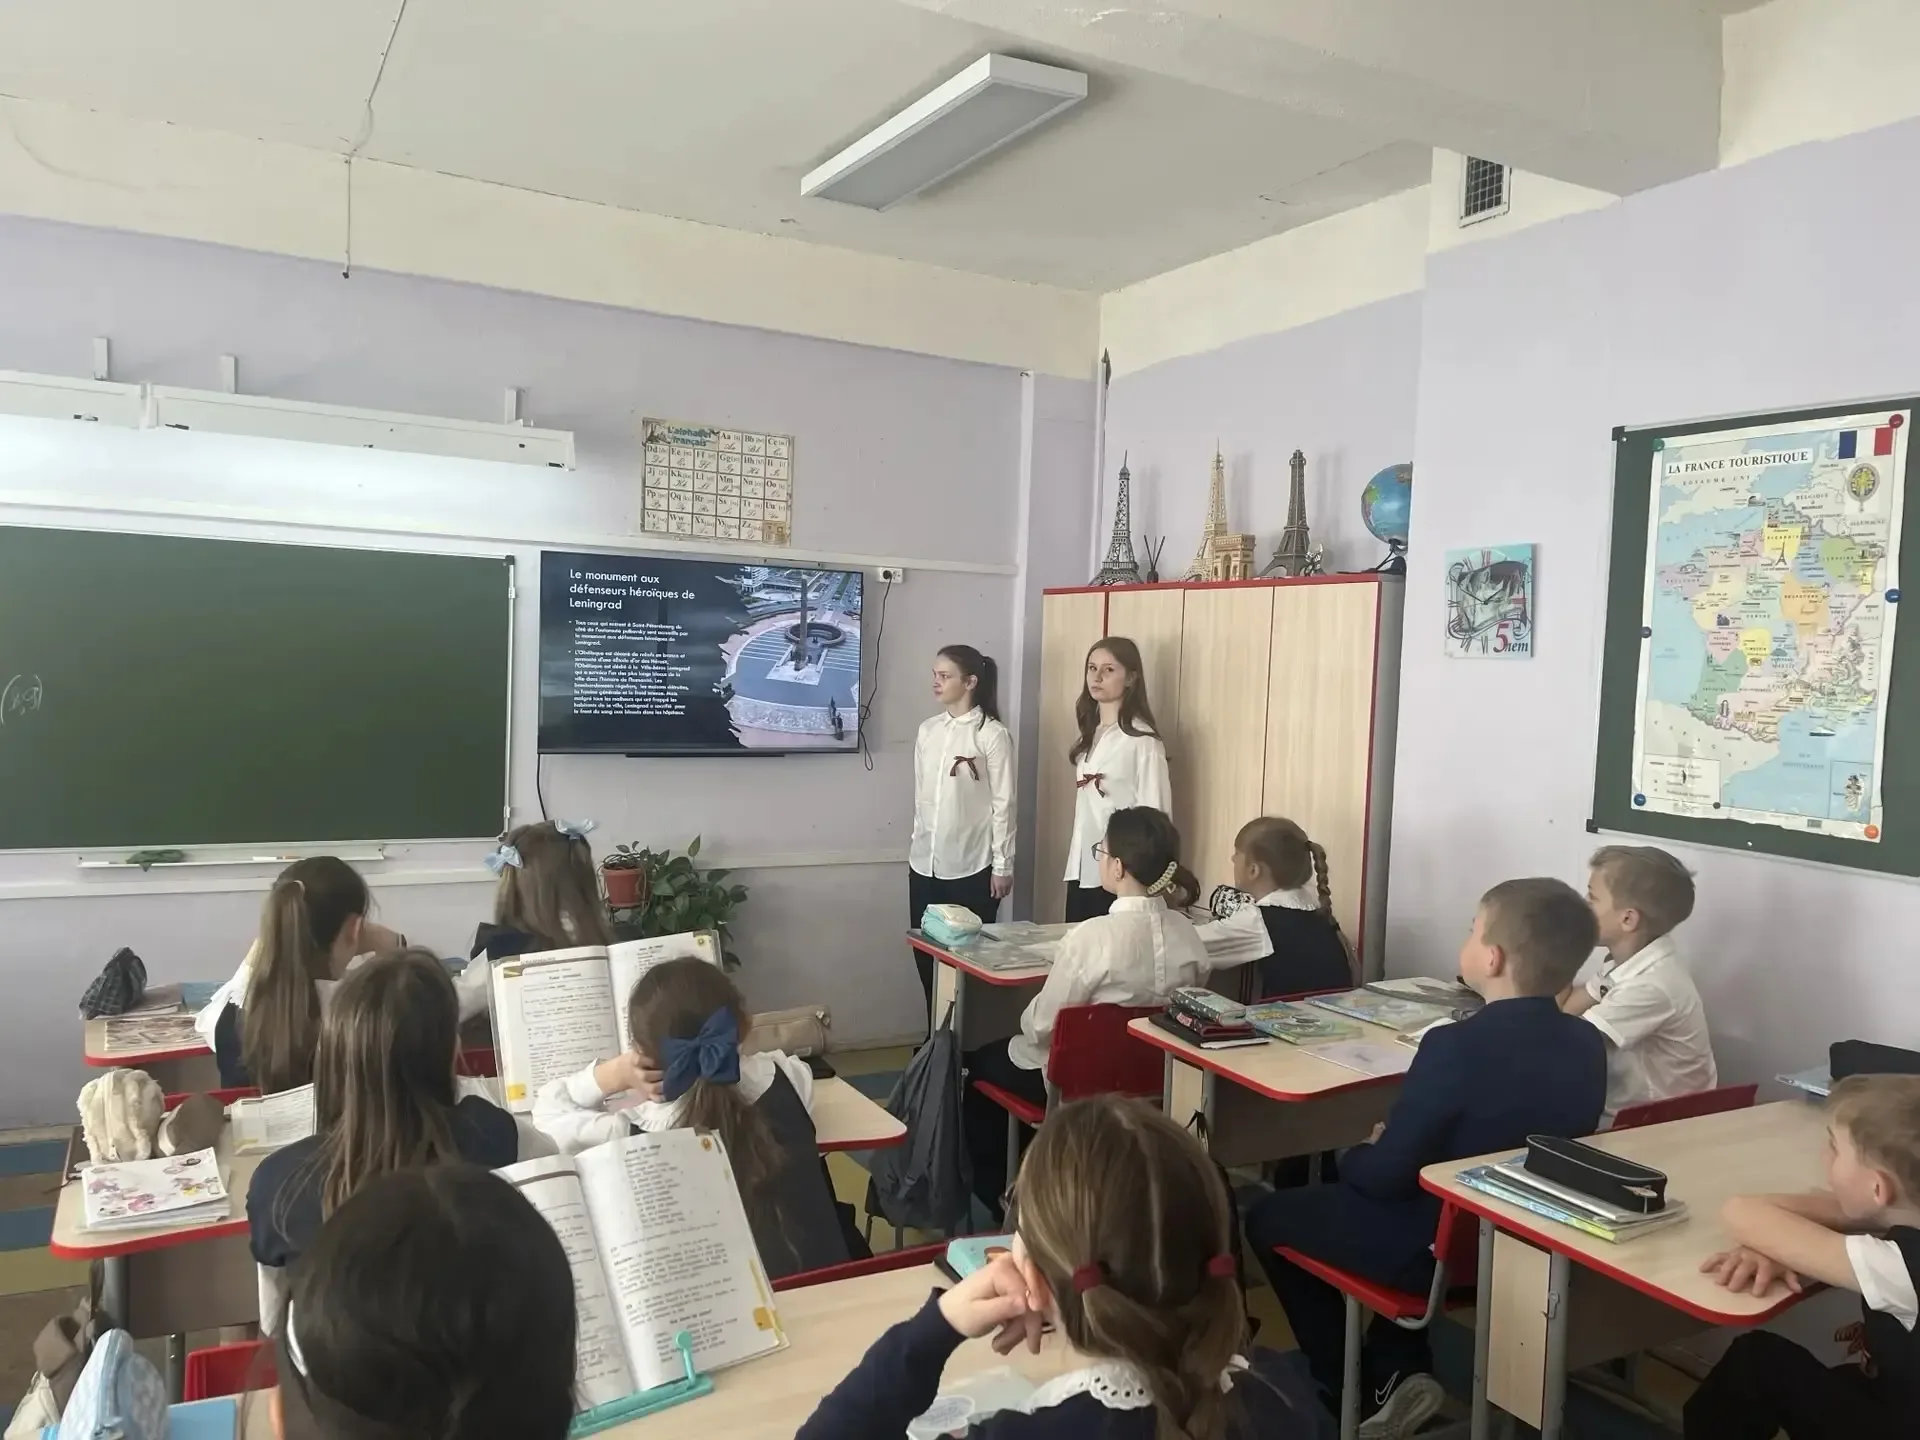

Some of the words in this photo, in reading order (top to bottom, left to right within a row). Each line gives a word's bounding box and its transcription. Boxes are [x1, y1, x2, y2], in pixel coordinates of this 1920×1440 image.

[673, 436, 706, 446] français
[1668, 464, 1680, 474] LA
[1685, 459, 1725, 472] FRANCE
[1729, 451, 1809, 468] TOURISTIQUE
[570, 569, 581, 579] Le
[586, 571, 637, 582] monument
[641, 575, 660, 583] aux
[570, 583, 627, 596] défenseurs
[629, 586, 679, 600] héroïques
[682, 590, 696, 599] de
[569, 598, 622, 611] Leningrad
[1493, 623, 1509, 653] 5
